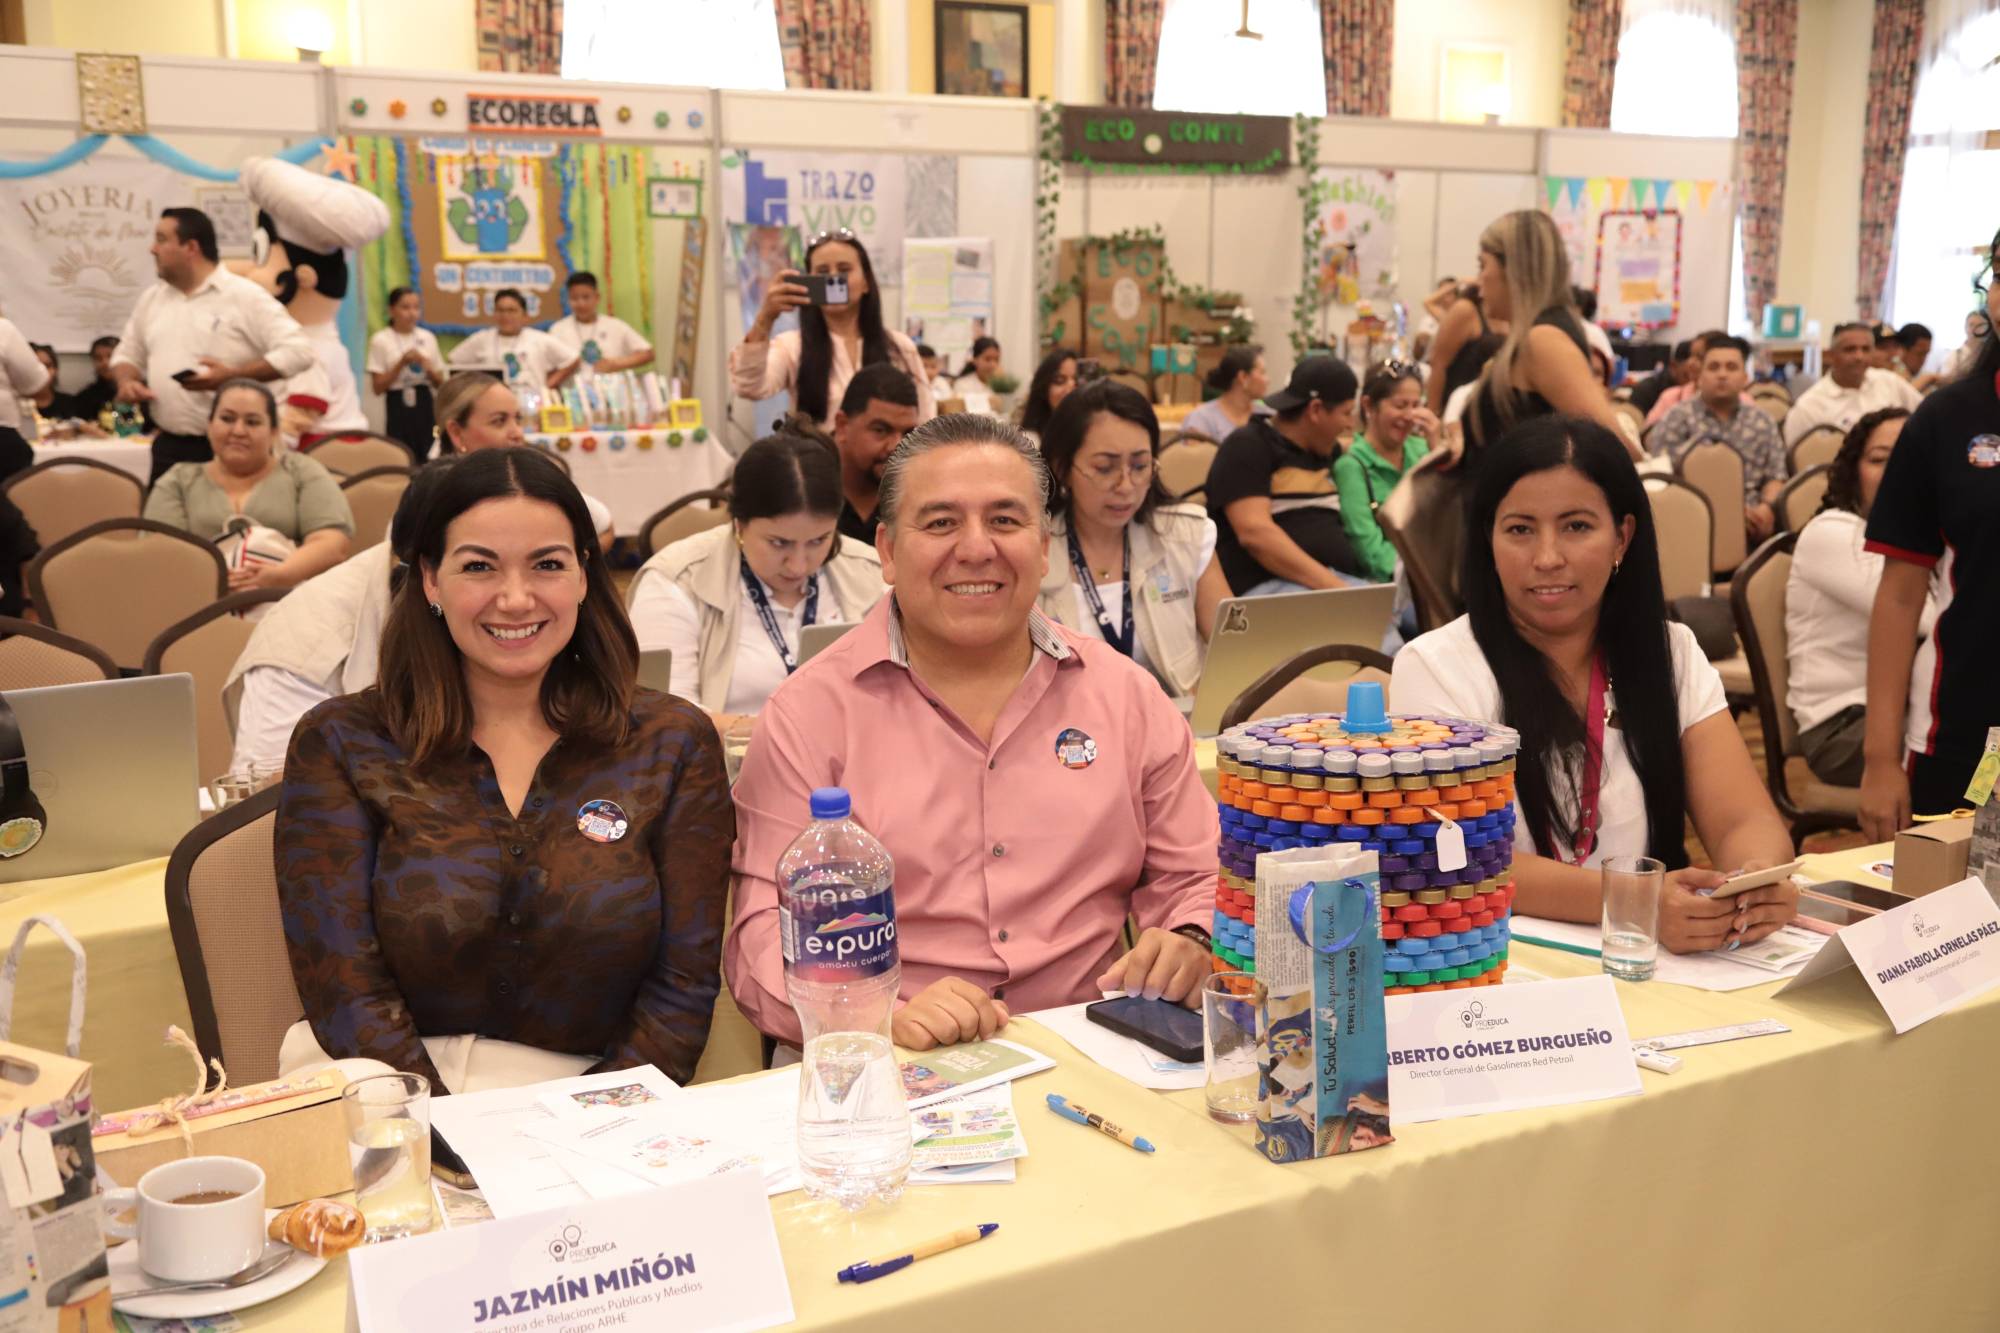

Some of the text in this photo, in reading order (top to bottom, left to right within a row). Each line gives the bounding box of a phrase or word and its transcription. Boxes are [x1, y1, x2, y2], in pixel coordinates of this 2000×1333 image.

[470, 100, 599, 128] ECOREGLA
[1084, 118, 1136, 142] ECO
[861, 950, 891, 966] cuerpo
[1877, 964, 1908, 984] DIANA
[1904, 948, 1942, 972] FABIOLA
[1940, 931, 1980, 956] ORNELAS
[1977, 921, 2000, 939] PÁEZ
[1347, 1001, 1356, 1035] PERFIL
[1475, 1017, 1509, 1027] PROEDUCA
[1323, 1033, 1338, 1075] Salud,
[1453, 1040, 1515, 1059] GÓMEZ
[1518, 1028, 1613, 1052] BURGUEÑO
[1410, 1054, 1575, 1079] Director General de Gasolineras Red Petroil
[1323, 1082, 1337, 1096] Tu
[570, 1241, 617, 1258] PROEDUCA
[473, 1252, 696, 1323] JAZMÍN MIÑÓN
[529, 1317, 544, 1329] de
[546, 1303, 606, 1325] Relaciones
[607, 1293, 654, 1312] Públicas
[654, 1292, 662, 1303] y
[663, 1281, 703, 1298] Medios
[597, 1312, 628, 1329] ARHE
